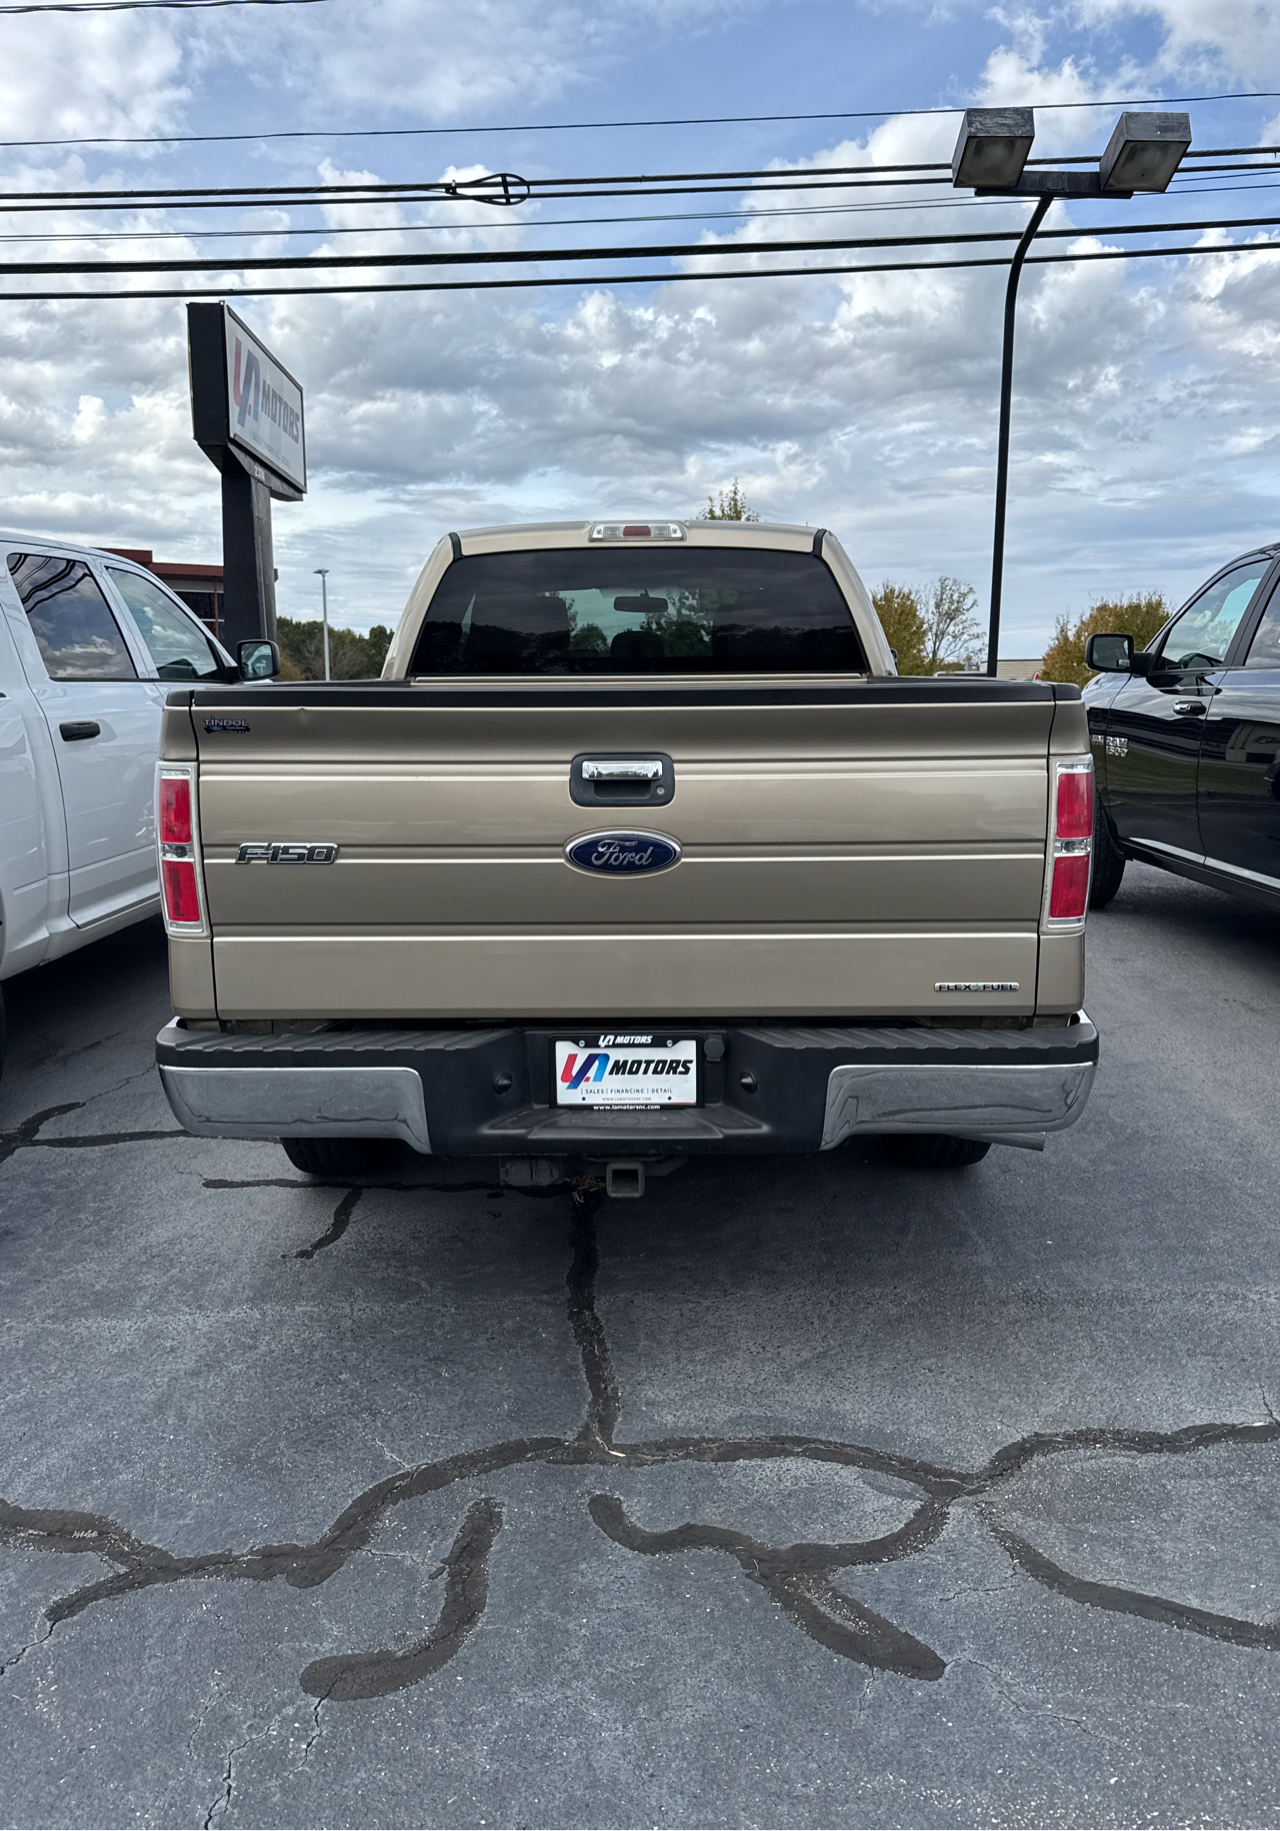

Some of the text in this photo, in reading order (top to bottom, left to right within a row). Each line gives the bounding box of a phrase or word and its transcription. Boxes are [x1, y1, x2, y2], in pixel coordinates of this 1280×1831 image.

[261, 379, 300, 444] MOTORS
[203, 718, 249, 727] TINDOL
[236, 842, 338, 865] F-150
[591, 839, 654, 866] Ford
[938, 983, 1018, 991] FLEX FUEL
[615, 1035, 653, 1044] MOTORS
[608, 1059, 694, 1075] MOTORS
